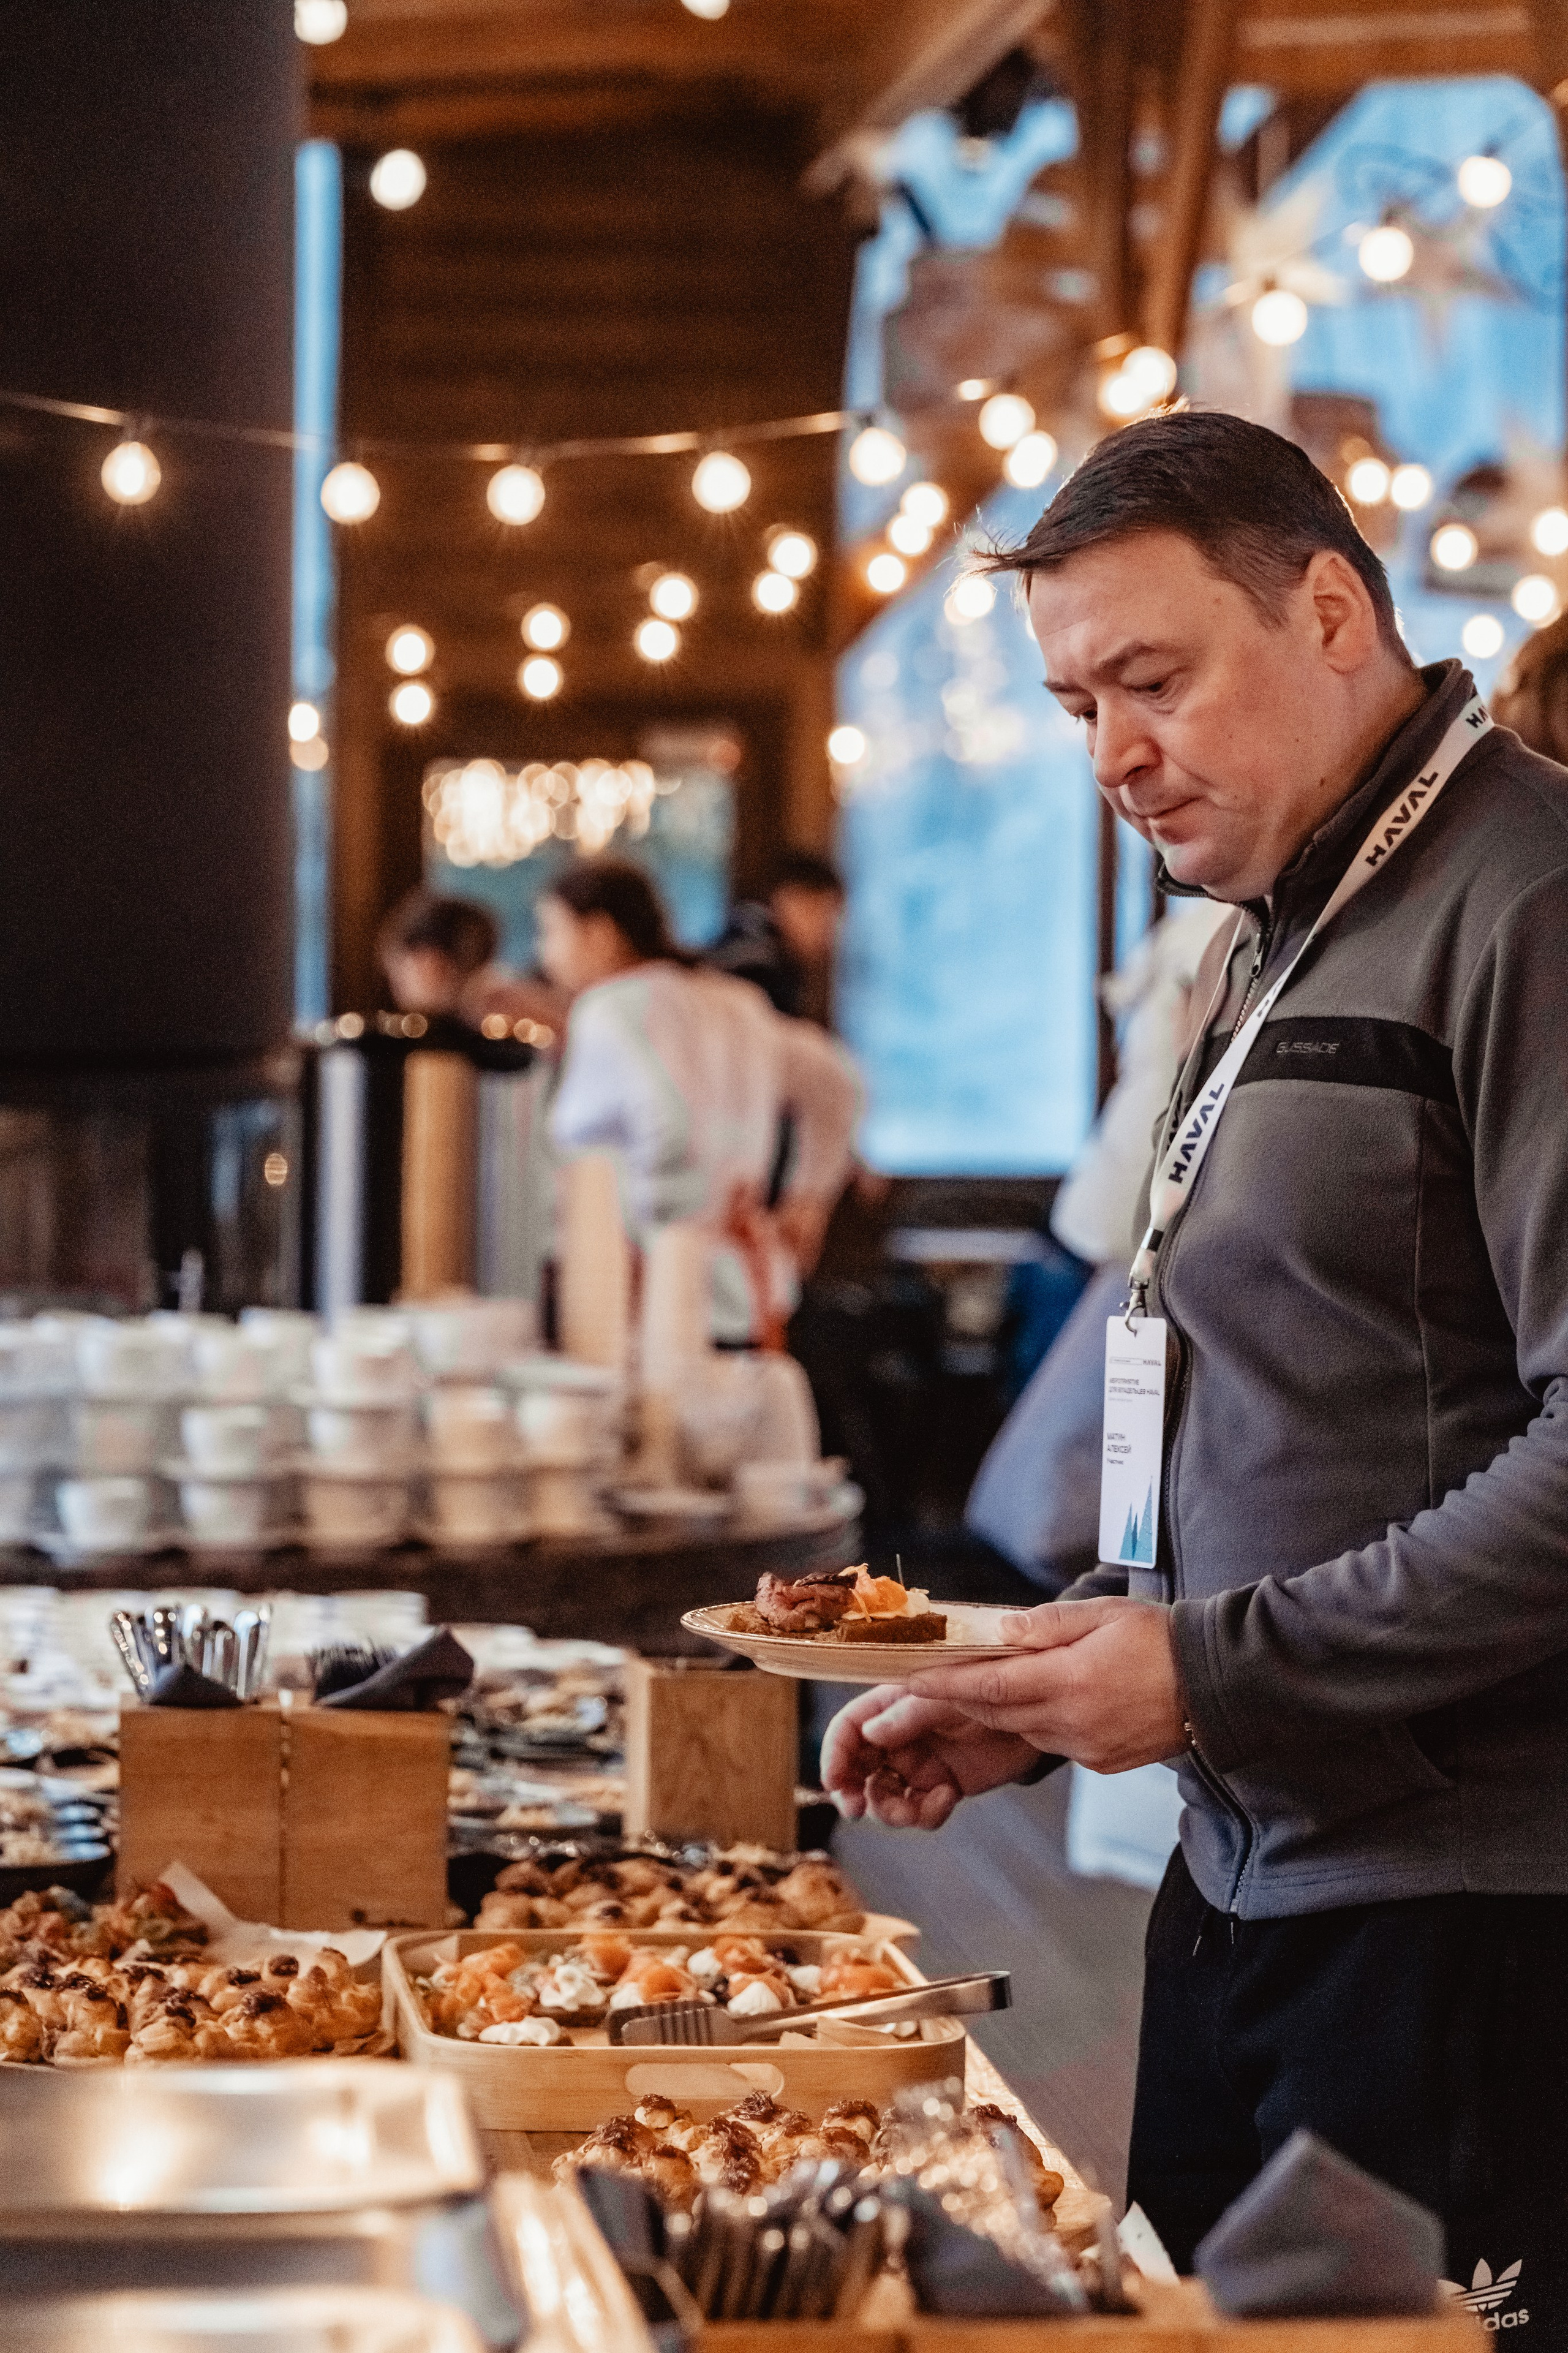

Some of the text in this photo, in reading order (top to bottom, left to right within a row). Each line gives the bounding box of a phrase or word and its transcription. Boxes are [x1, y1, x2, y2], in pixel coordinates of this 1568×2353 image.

[1365, 772, 1439, 866] HAVAL
[1168, 1084, 1224, 1184] HAVAL
[1476, 2309, 1530, 2332] das
